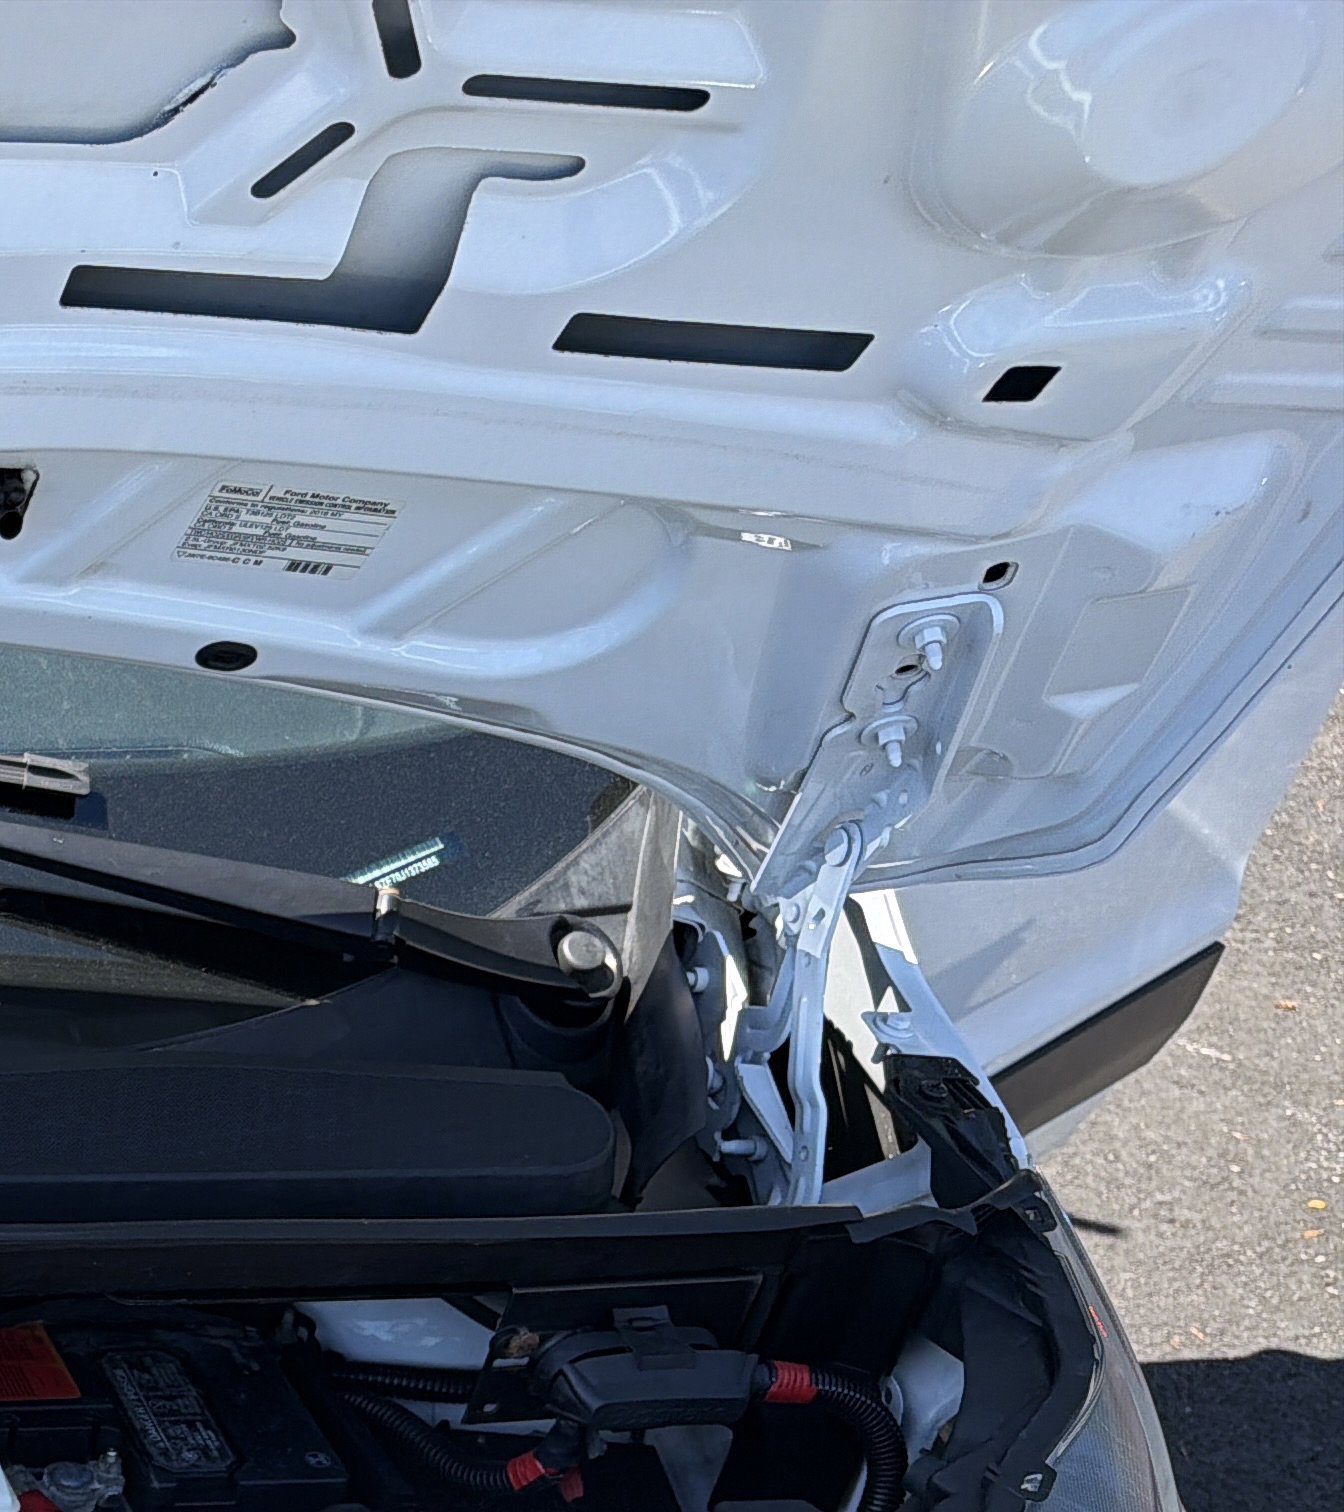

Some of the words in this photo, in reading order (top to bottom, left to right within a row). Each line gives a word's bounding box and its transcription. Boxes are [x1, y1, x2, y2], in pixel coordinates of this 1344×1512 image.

[283, 489, 308, 498] Ford
[310, 492, 340, 502] Motor
[342, 496, 390, 508] Company
